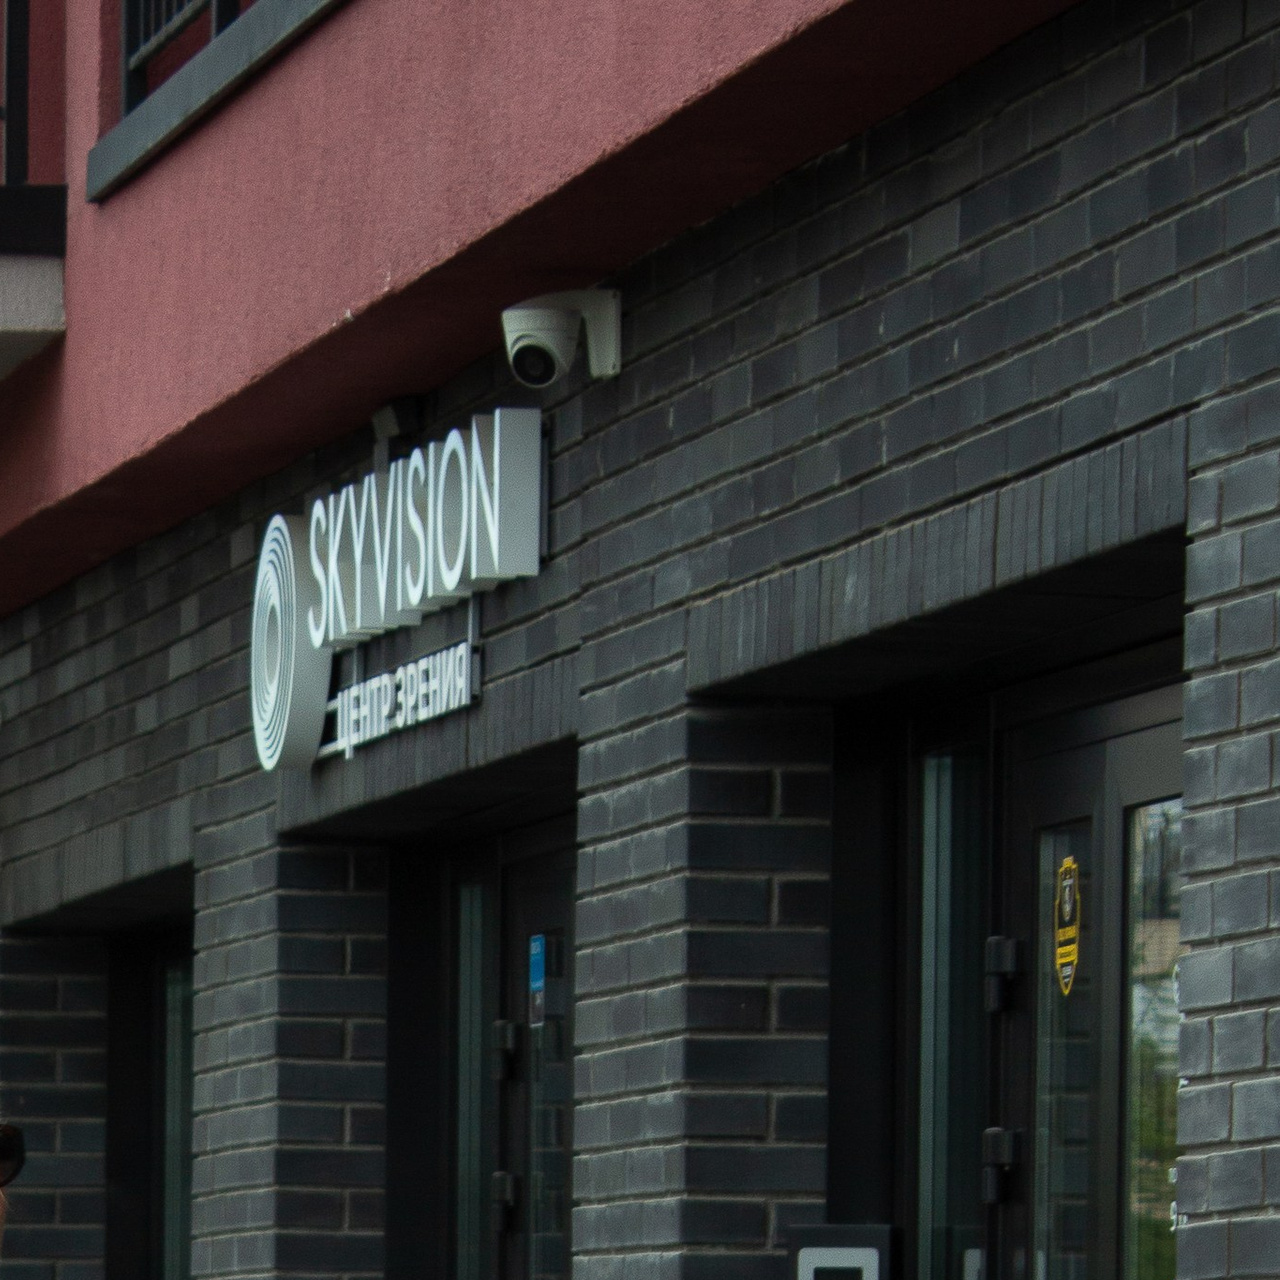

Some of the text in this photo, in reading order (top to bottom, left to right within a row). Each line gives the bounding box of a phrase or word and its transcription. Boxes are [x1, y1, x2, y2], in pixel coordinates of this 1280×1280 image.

[307, 407, 501, 650] SKYVISION
[336, 641, 468, 760] ЦЕНТР ЗРЕНИЯ
